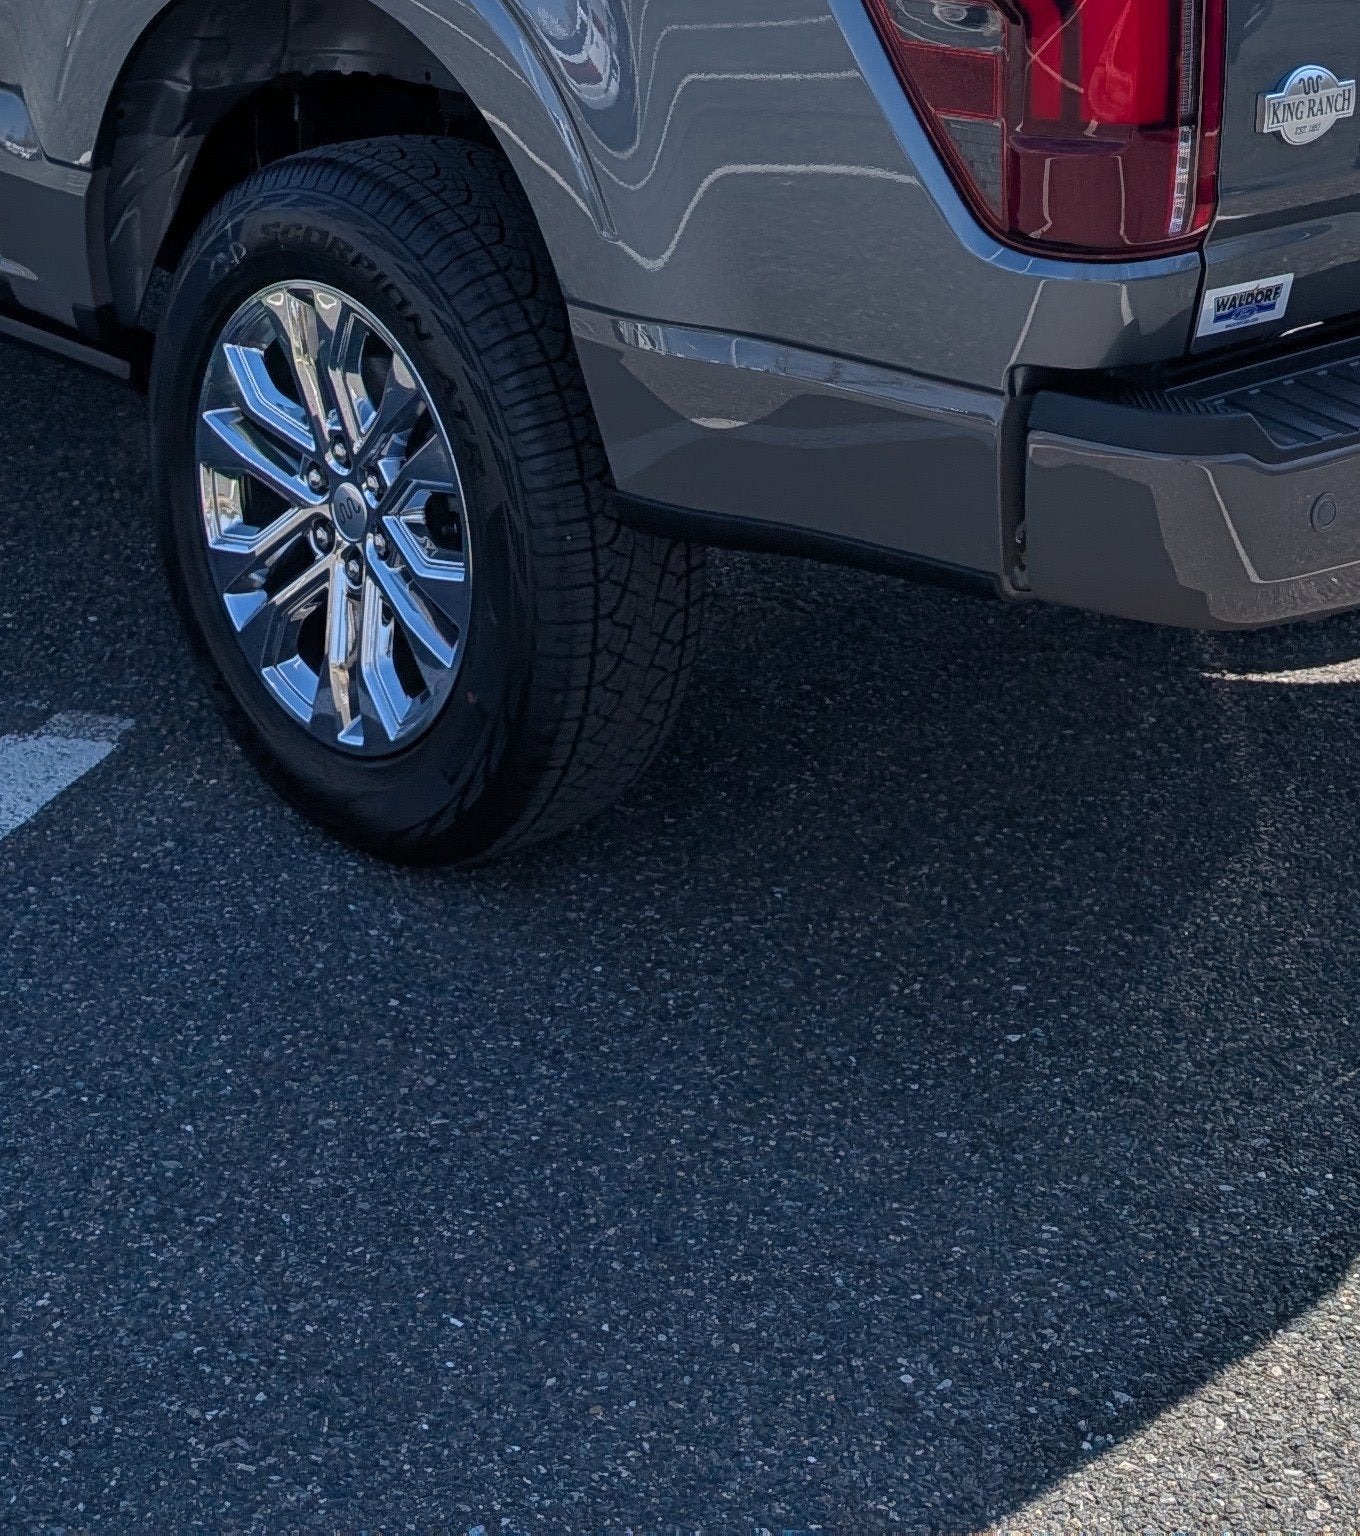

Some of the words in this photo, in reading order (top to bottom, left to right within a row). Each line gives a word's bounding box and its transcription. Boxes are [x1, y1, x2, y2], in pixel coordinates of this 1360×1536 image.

[1271, 101, 1305, 125] KING
[1307, 89, 1352, 118] RANCH
[1215, 283, 1283, 312] WALDORF
